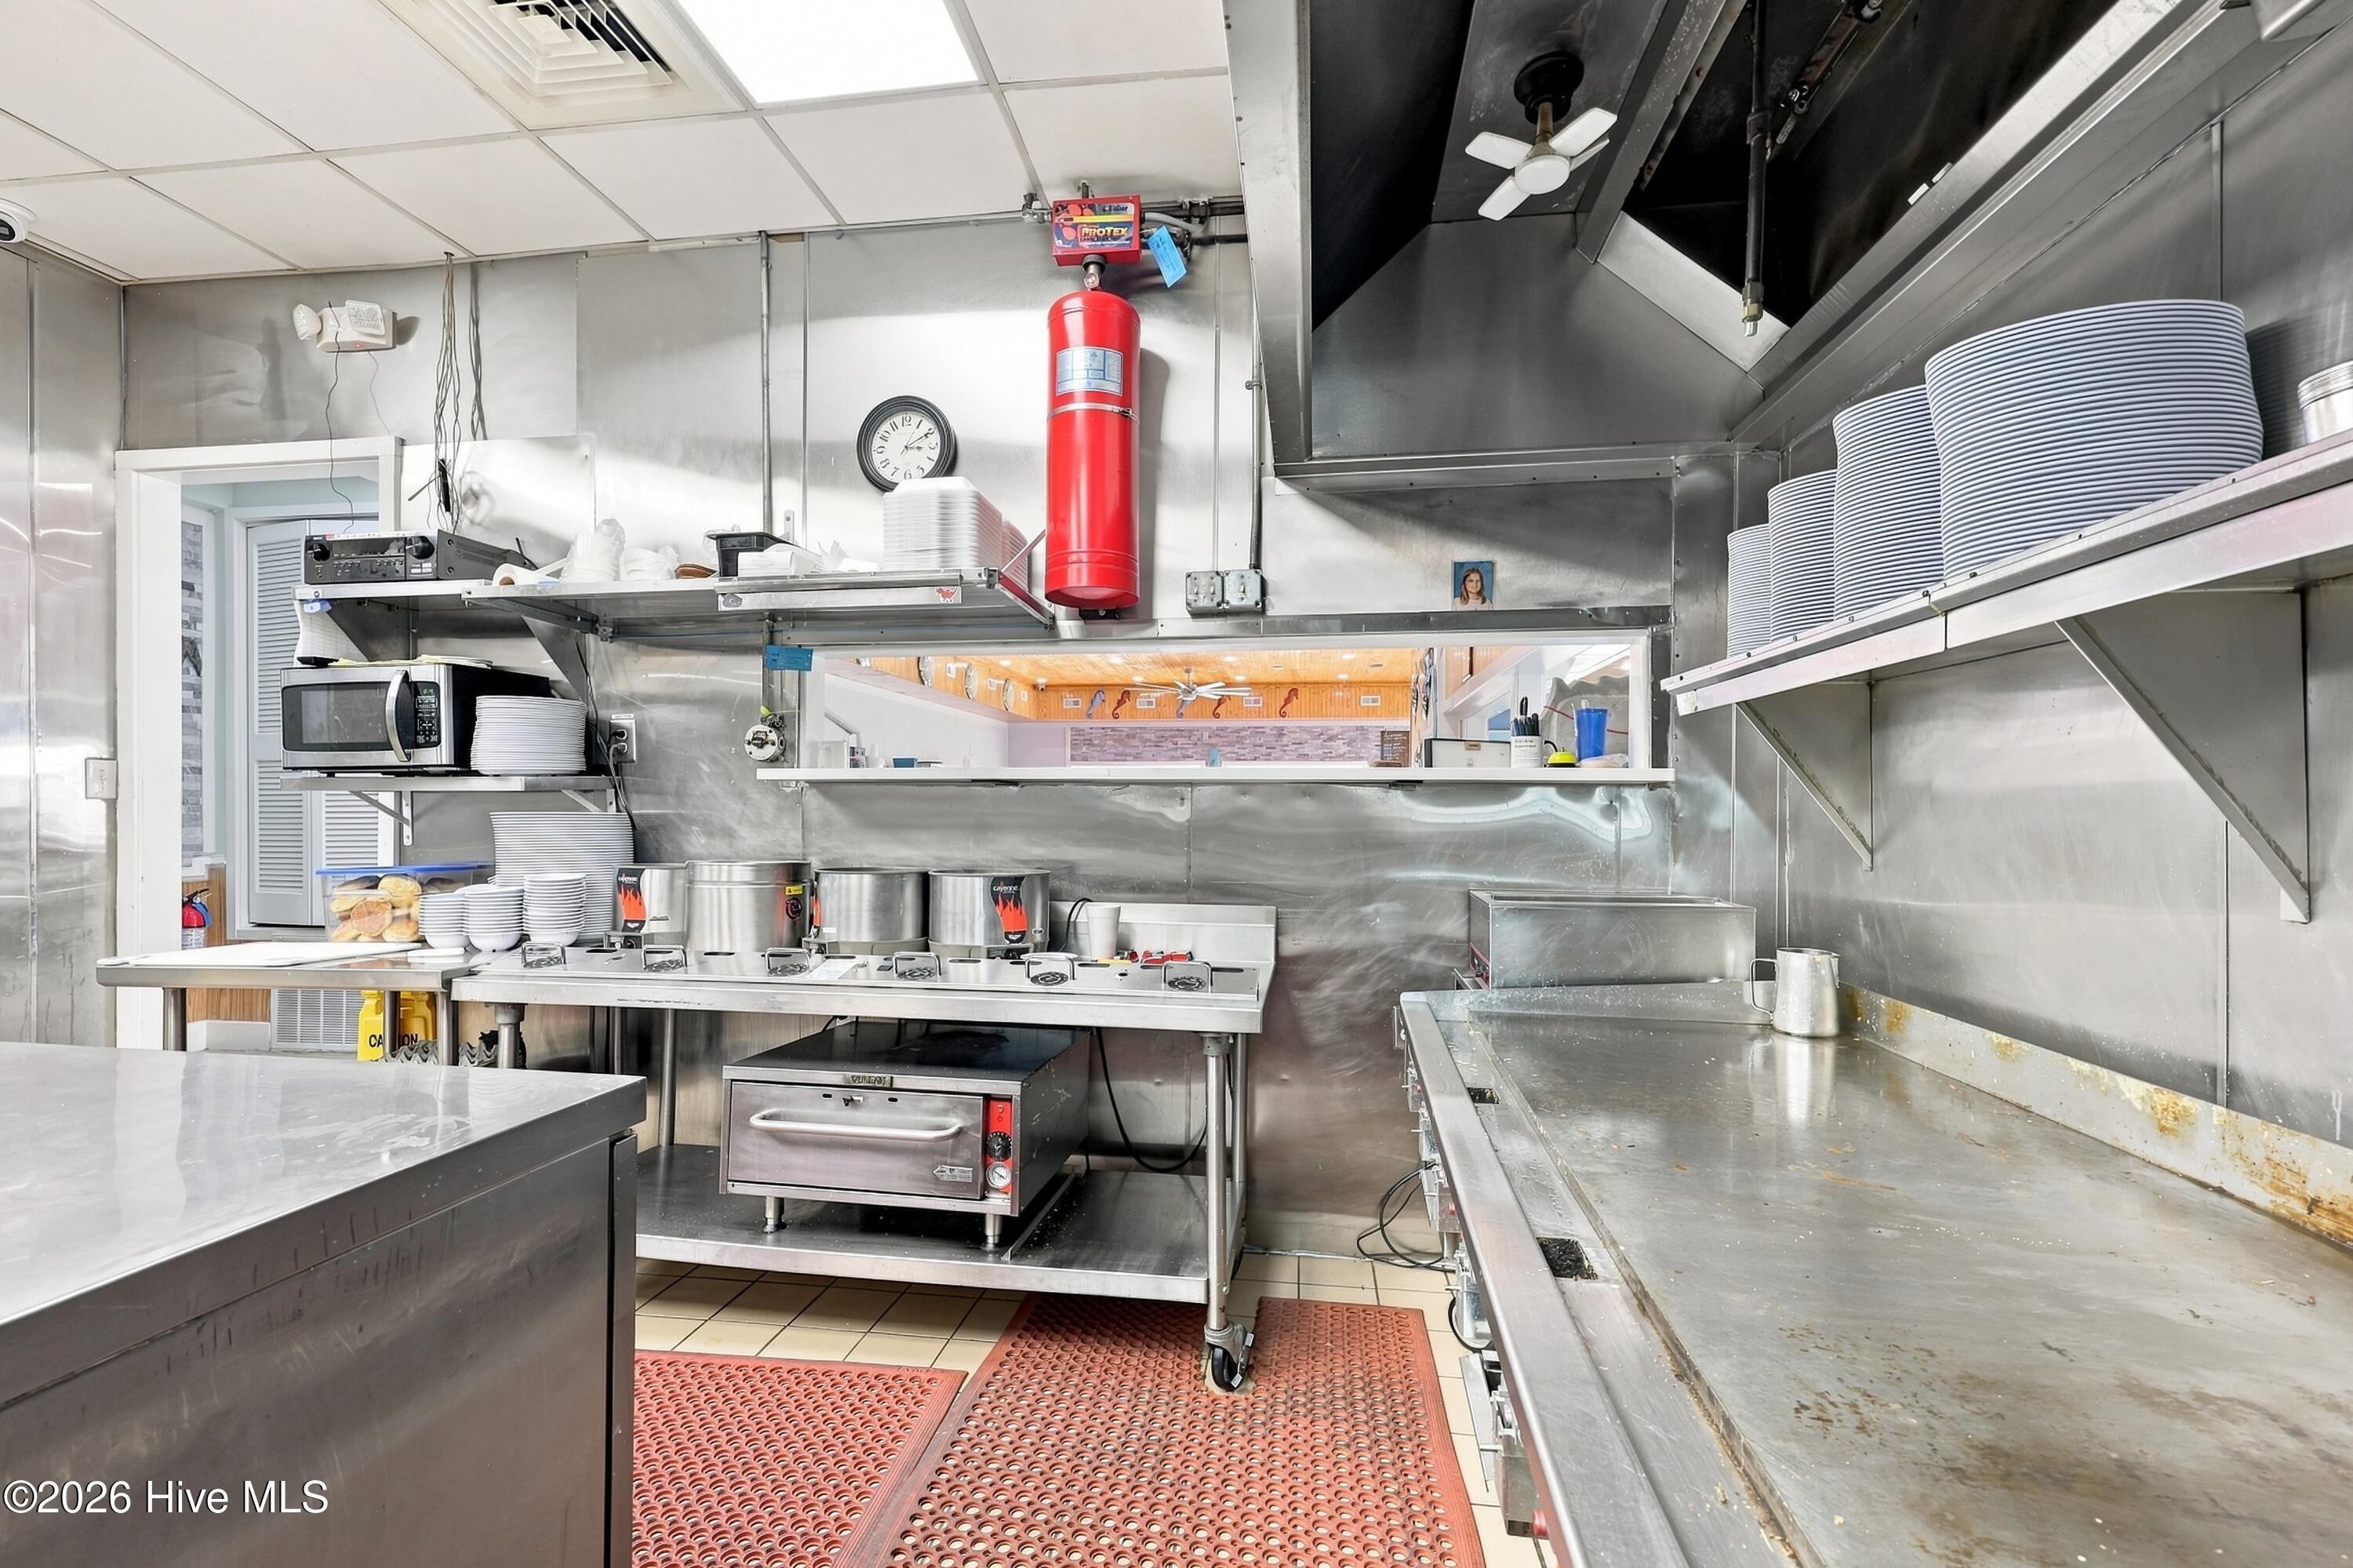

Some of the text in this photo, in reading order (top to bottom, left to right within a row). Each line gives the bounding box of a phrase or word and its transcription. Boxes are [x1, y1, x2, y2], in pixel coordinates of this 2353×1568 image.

[889, 420, 899, 431] 11
[901, 415, 911, 427] 12
[916, 419, 923, 428] 1
[879, 430, 891, 442] 10
[876, 446, 886, 454] 9
[879, 458, 890, 468] 8
[891, 467, 900, 476] 7
[904, 471, 912, 479] 6
[369, 1033, 418, 1048] CAON
